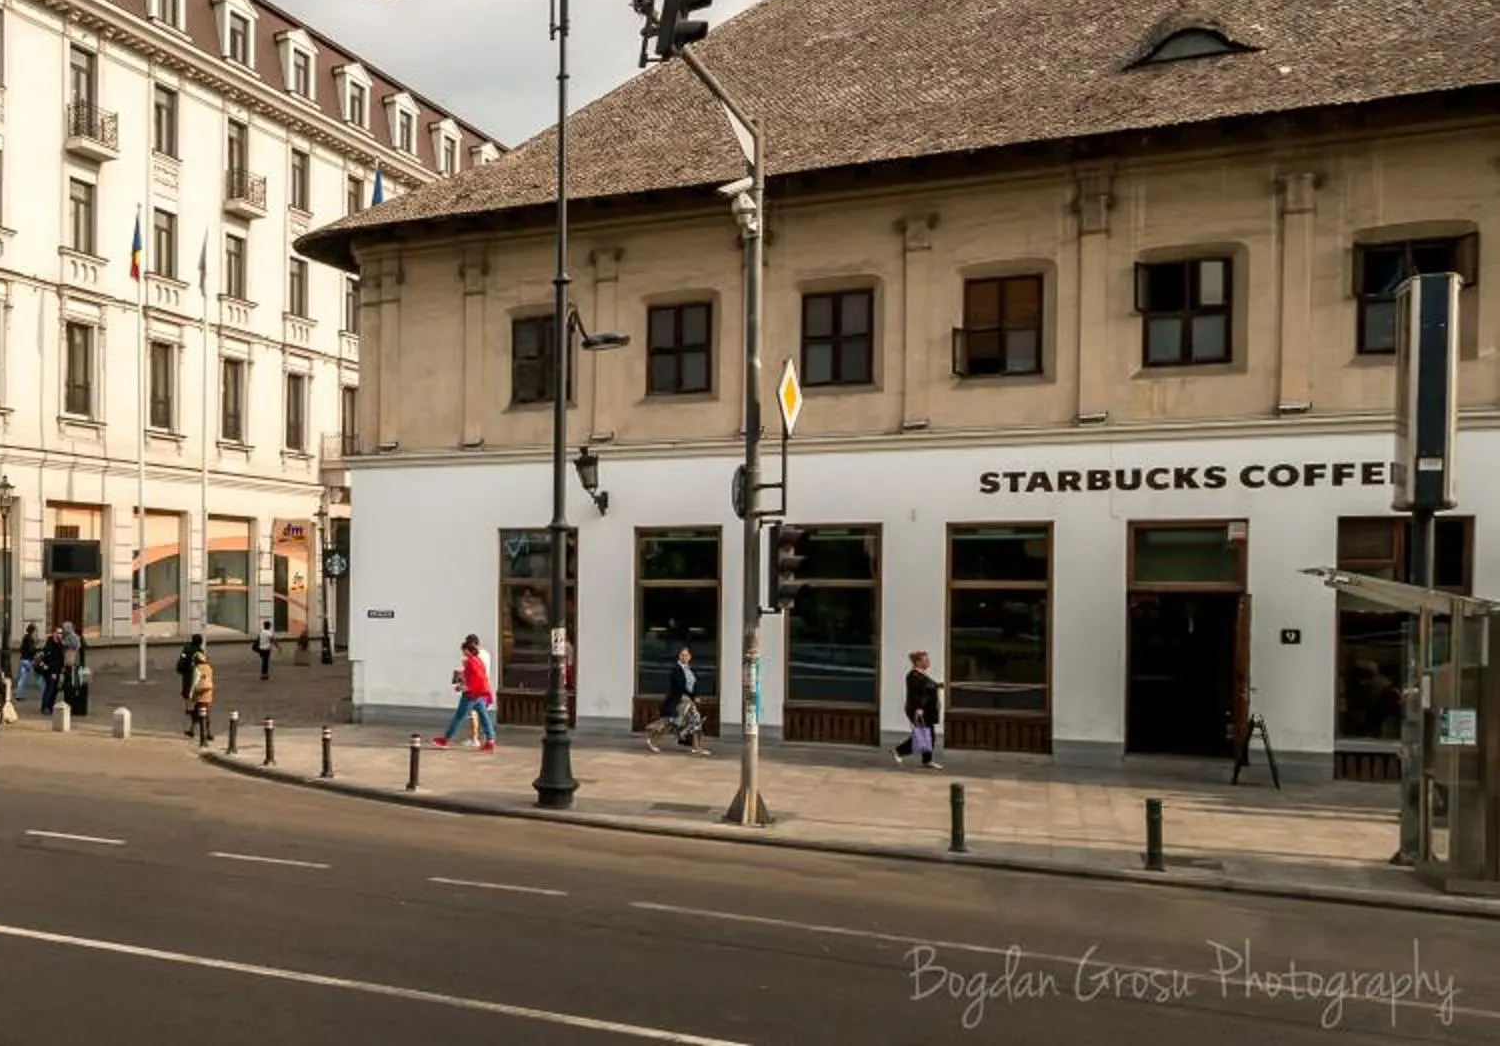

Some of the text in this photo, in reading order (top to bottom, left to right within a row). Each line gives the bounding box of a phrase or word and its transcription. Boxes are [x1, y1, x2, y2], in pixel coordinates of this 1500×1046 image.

[979, 461, 1397, 494] STARBUCKS COFFE
[283, 523, 304, 537] dm
